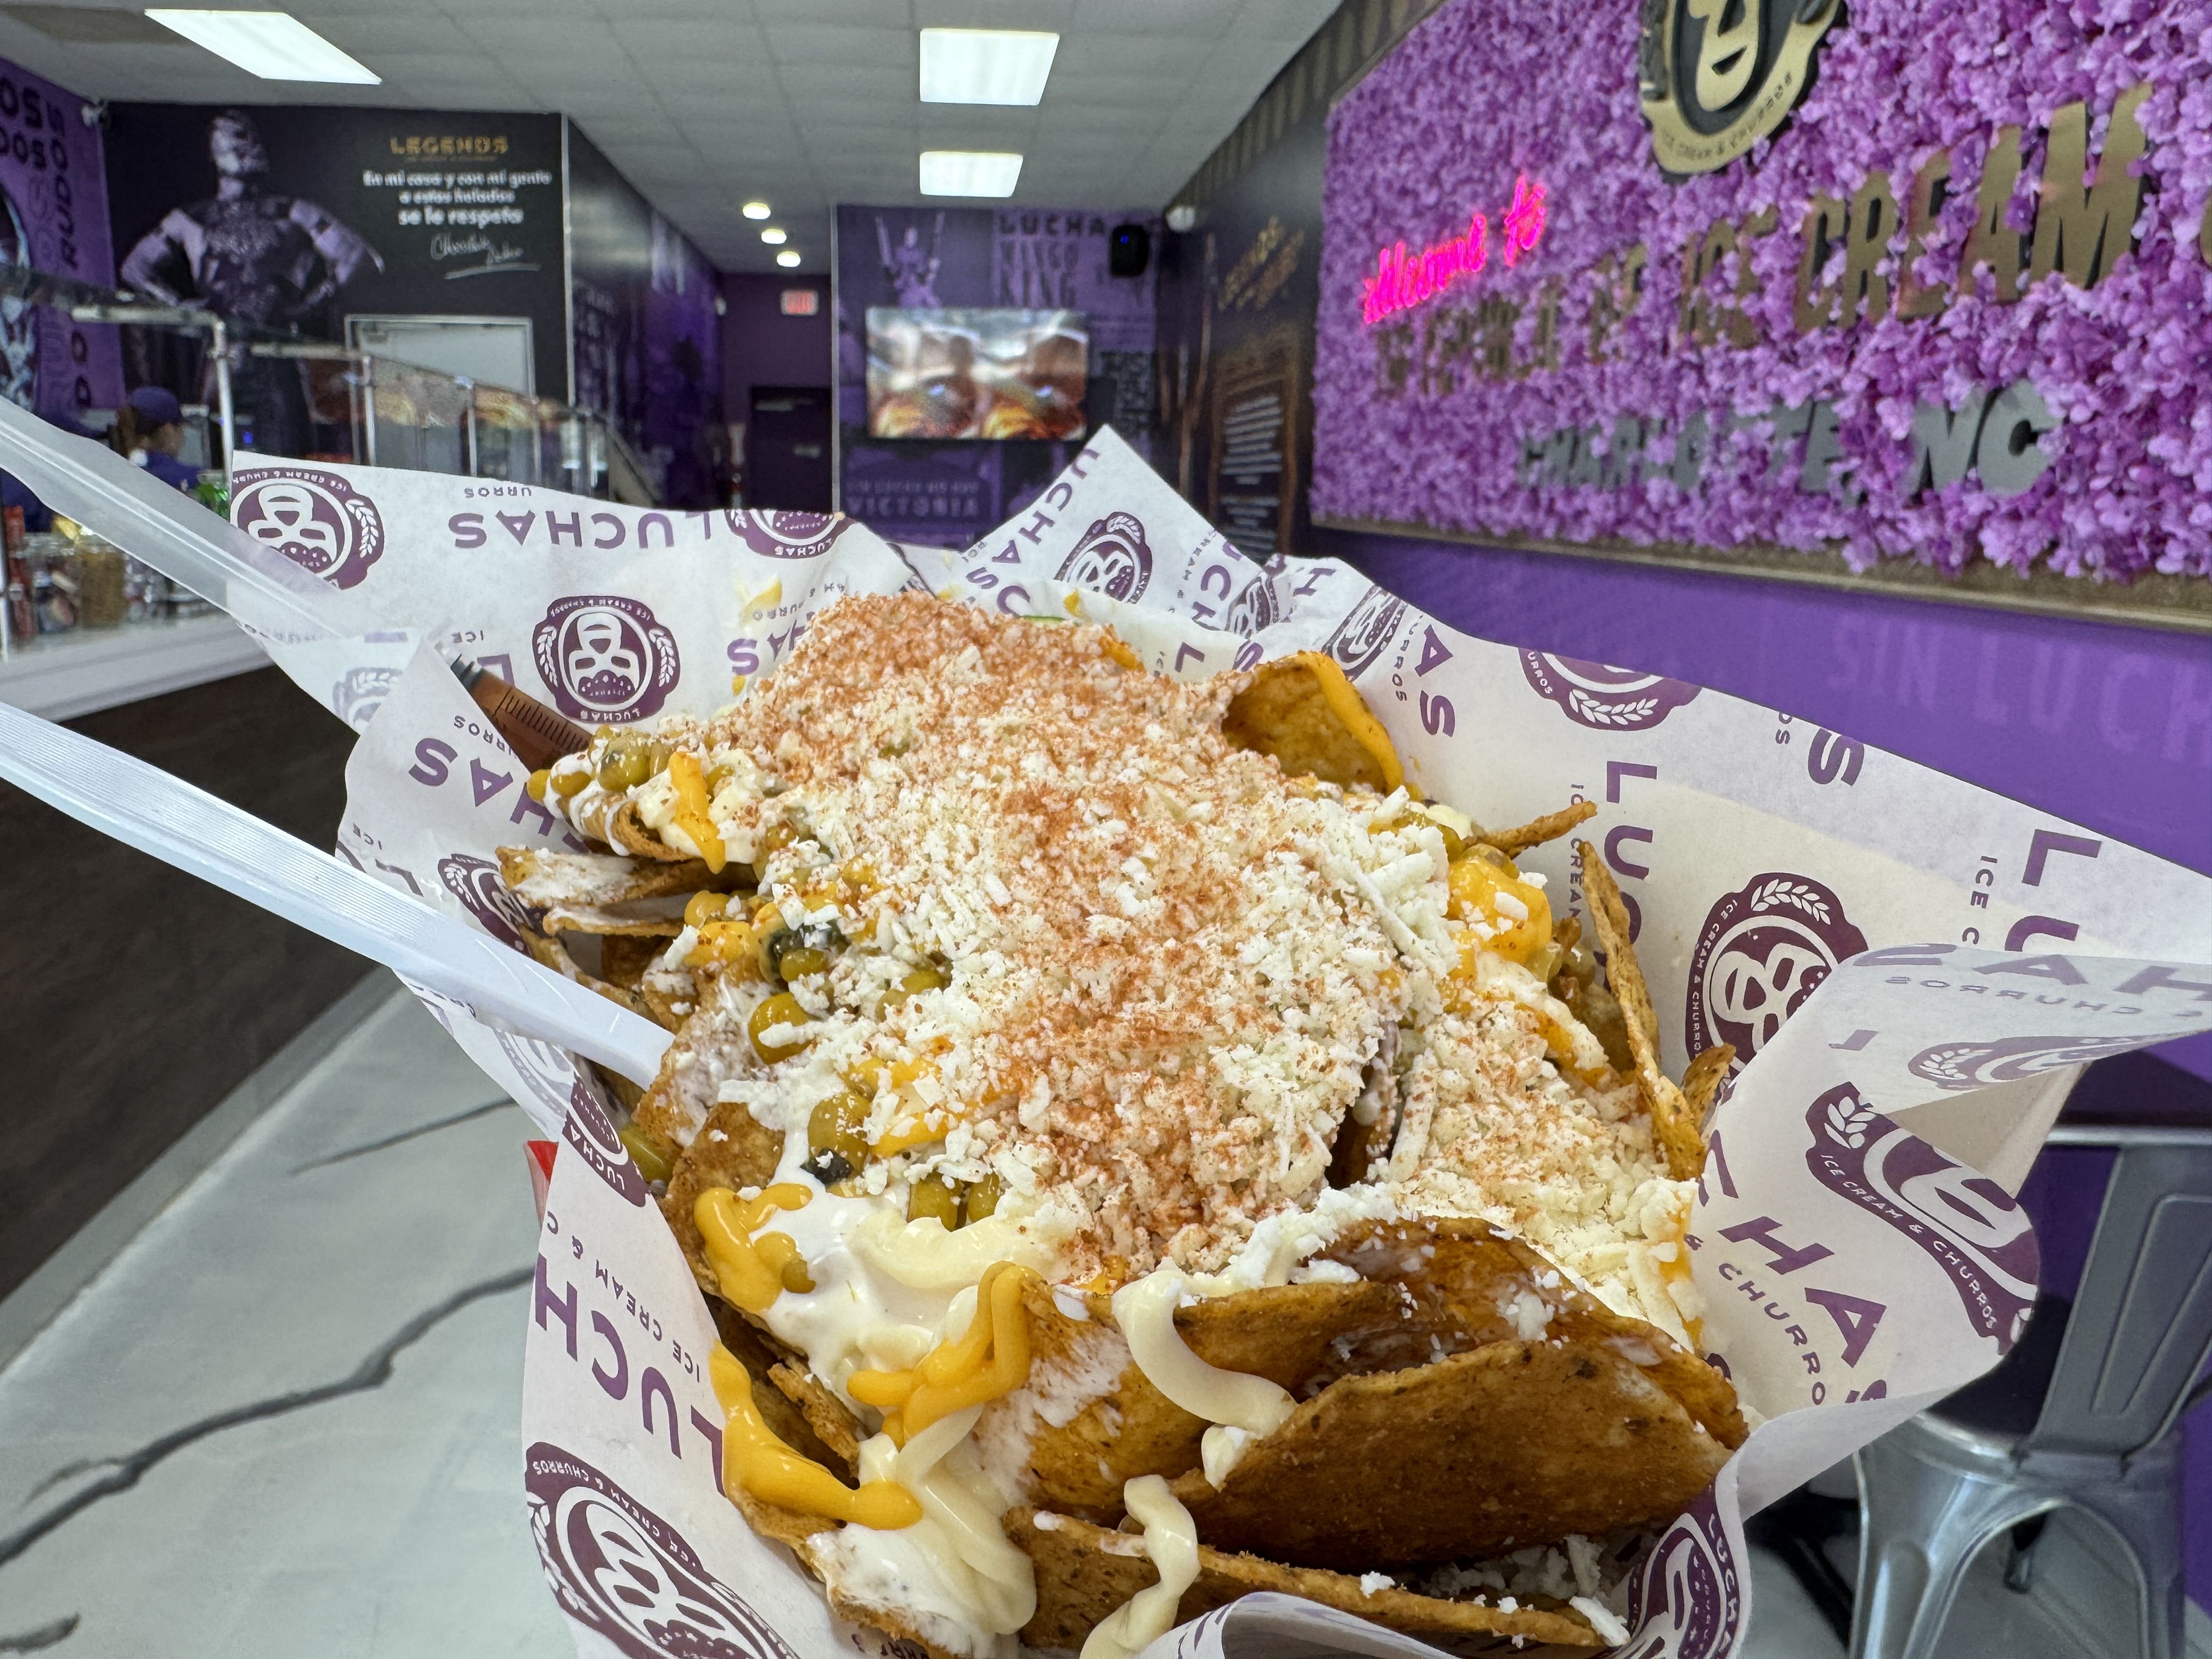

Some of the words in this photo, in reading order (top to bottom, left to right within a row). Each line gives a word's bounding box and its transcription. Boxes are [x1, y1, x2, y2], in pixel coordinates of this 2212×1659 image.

[390, 136, 509, 154] LEGENDS
[398, 209, 422, 225] se
[424, 205, 445, 225] le
[999, 215, 1106, 236] LUCHA
[1792, 81, 2155, 332] CREAM
[1905, 377, 2065, 498] NC
[448, 509, 712, 549] LUCHAS
[1970, 855, 1998, 909] ICE
[1720, 899, 1739, 920] ICE
[1696, 923, 1720, 969] CREAM
[1691, 990, 1702, 1054] CHURRO
[1819, 1154, 1845, 1177] ICE
[1842, 1180, 1904, 1220] CREAM
[1908, 1223, 1925, 1235] &
[1932, 1239, 1999, 1330] CHURROS
[595, 1259, 663, 1342] CREAM
[672, 1339, 701, 1383] ICE
[532, 1459, 590, 1482] CHURROS
[610, 1487, 661, 1538] CREAM
